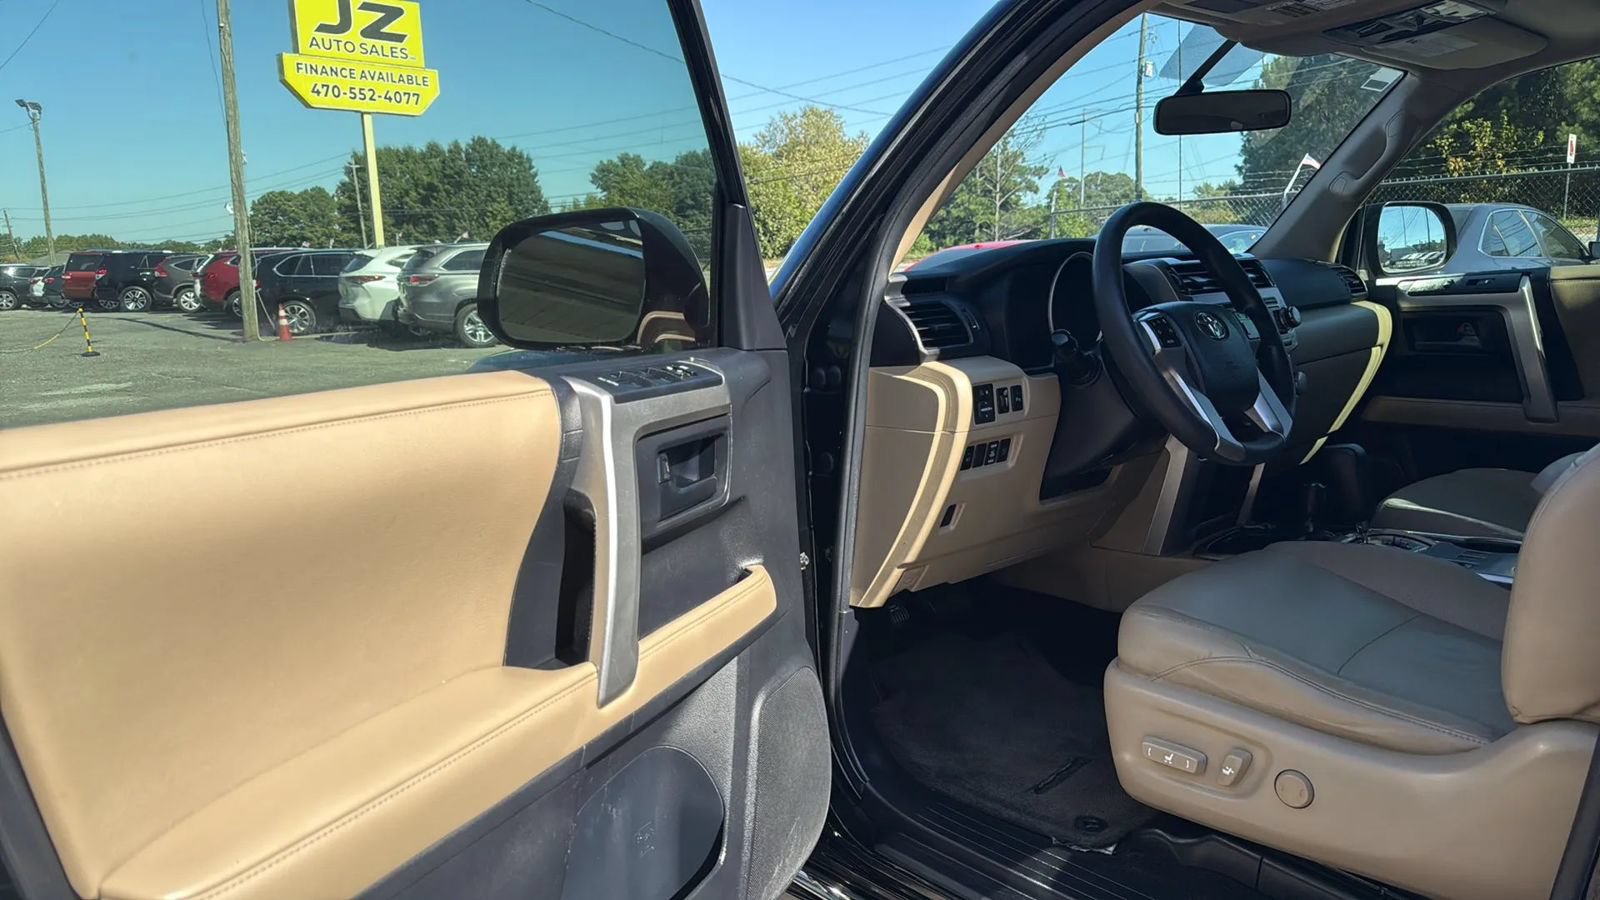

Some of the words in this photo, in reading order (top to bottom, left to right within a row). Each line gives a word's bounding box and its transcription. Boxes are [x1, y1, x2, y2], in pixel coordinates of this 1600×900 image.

[314, 0, 408, 43] JZ
[309, 36, 356, 54] AUTO
[360, 42, 409, 60] SALES
[296, 62, 356, 80] FINANCE
[360, 70, 429, 87] AVAILABLE
[311, 83, 420, 106] 470-552-4077
